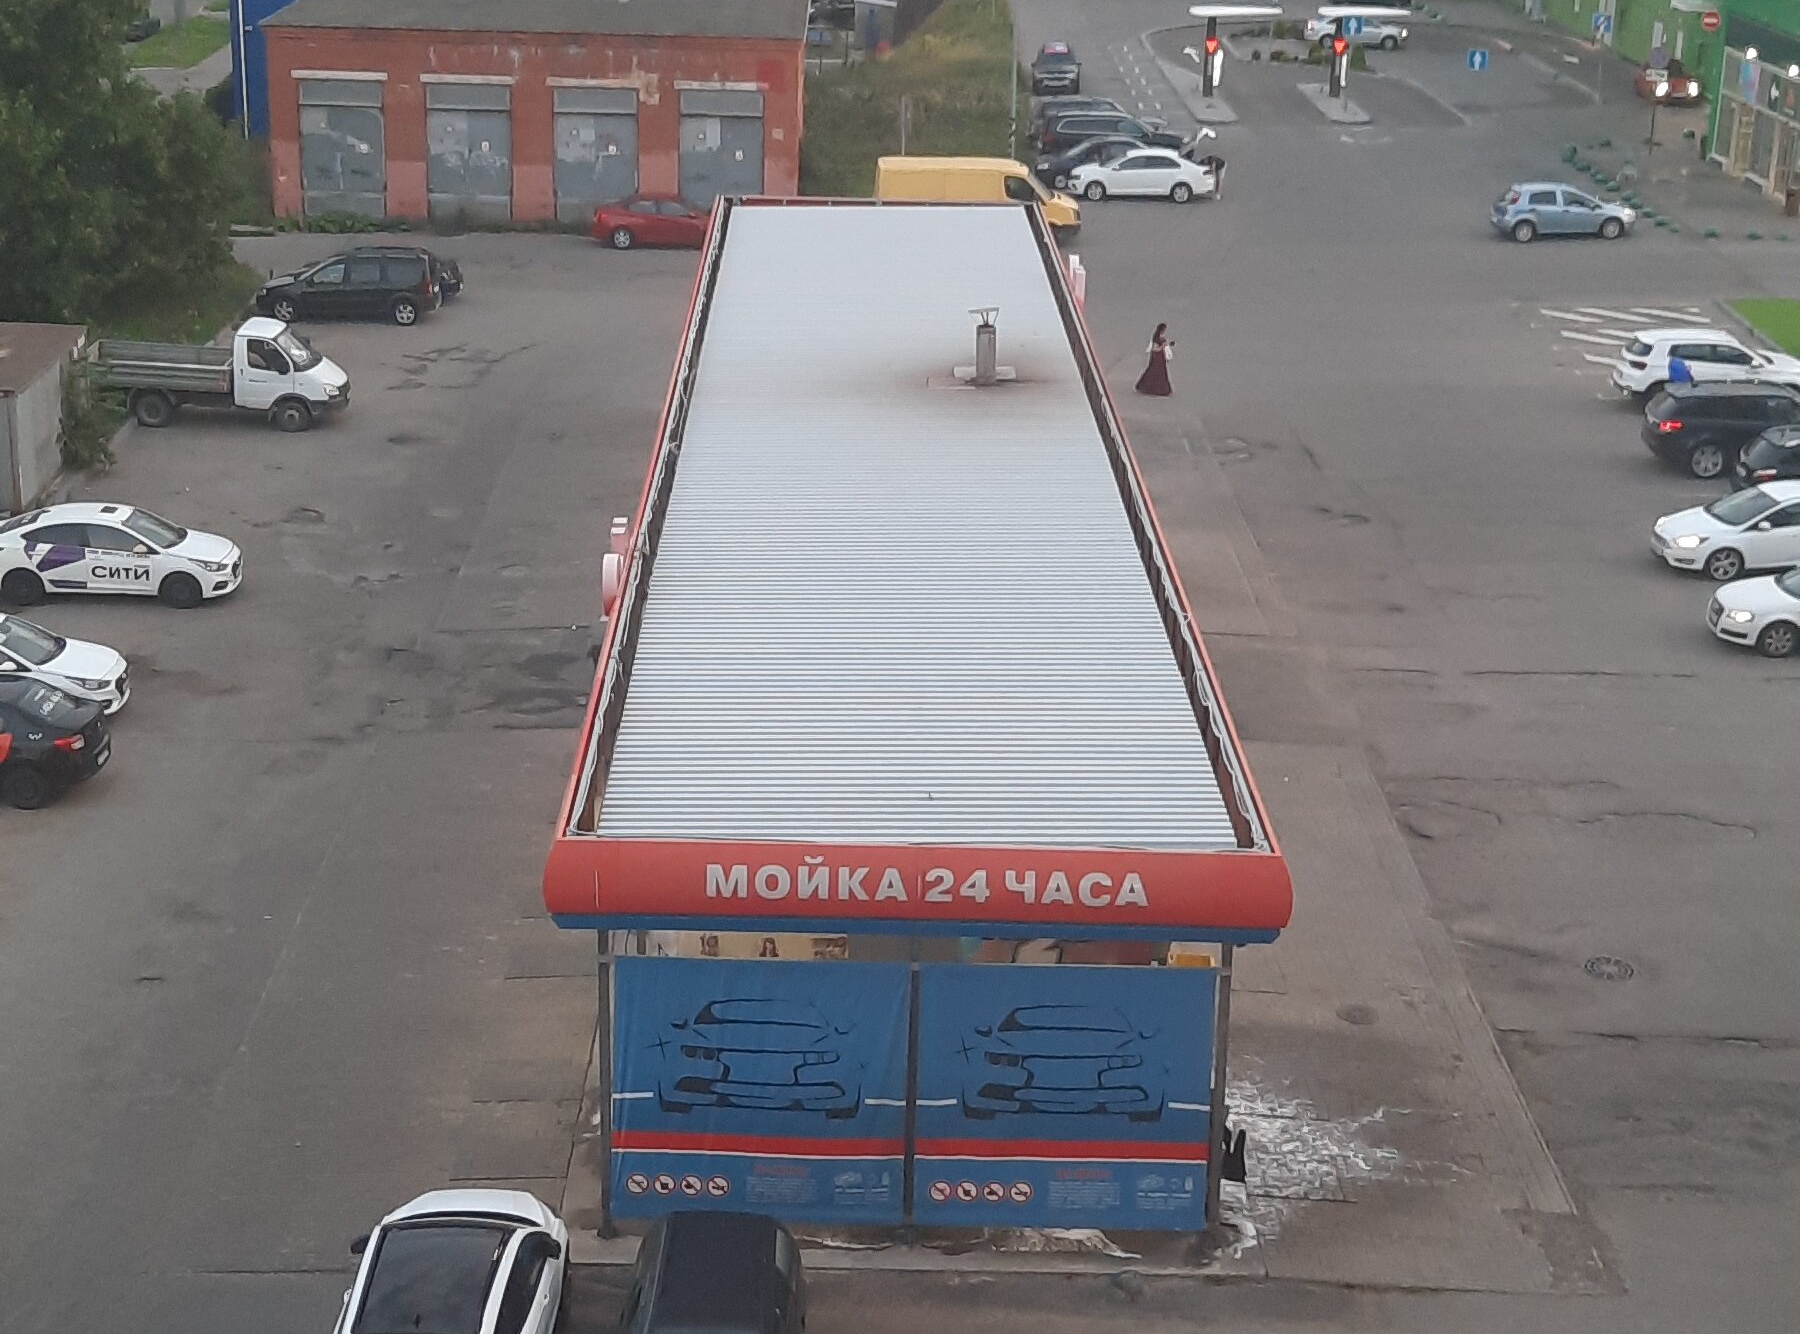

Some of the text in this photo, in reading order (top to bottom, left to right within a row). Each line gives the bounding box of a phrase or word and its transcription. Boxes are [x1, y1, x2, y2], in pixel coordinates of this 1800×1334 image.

[705, 854, 1150, 908] МОЙКА 24 ЧАСА
